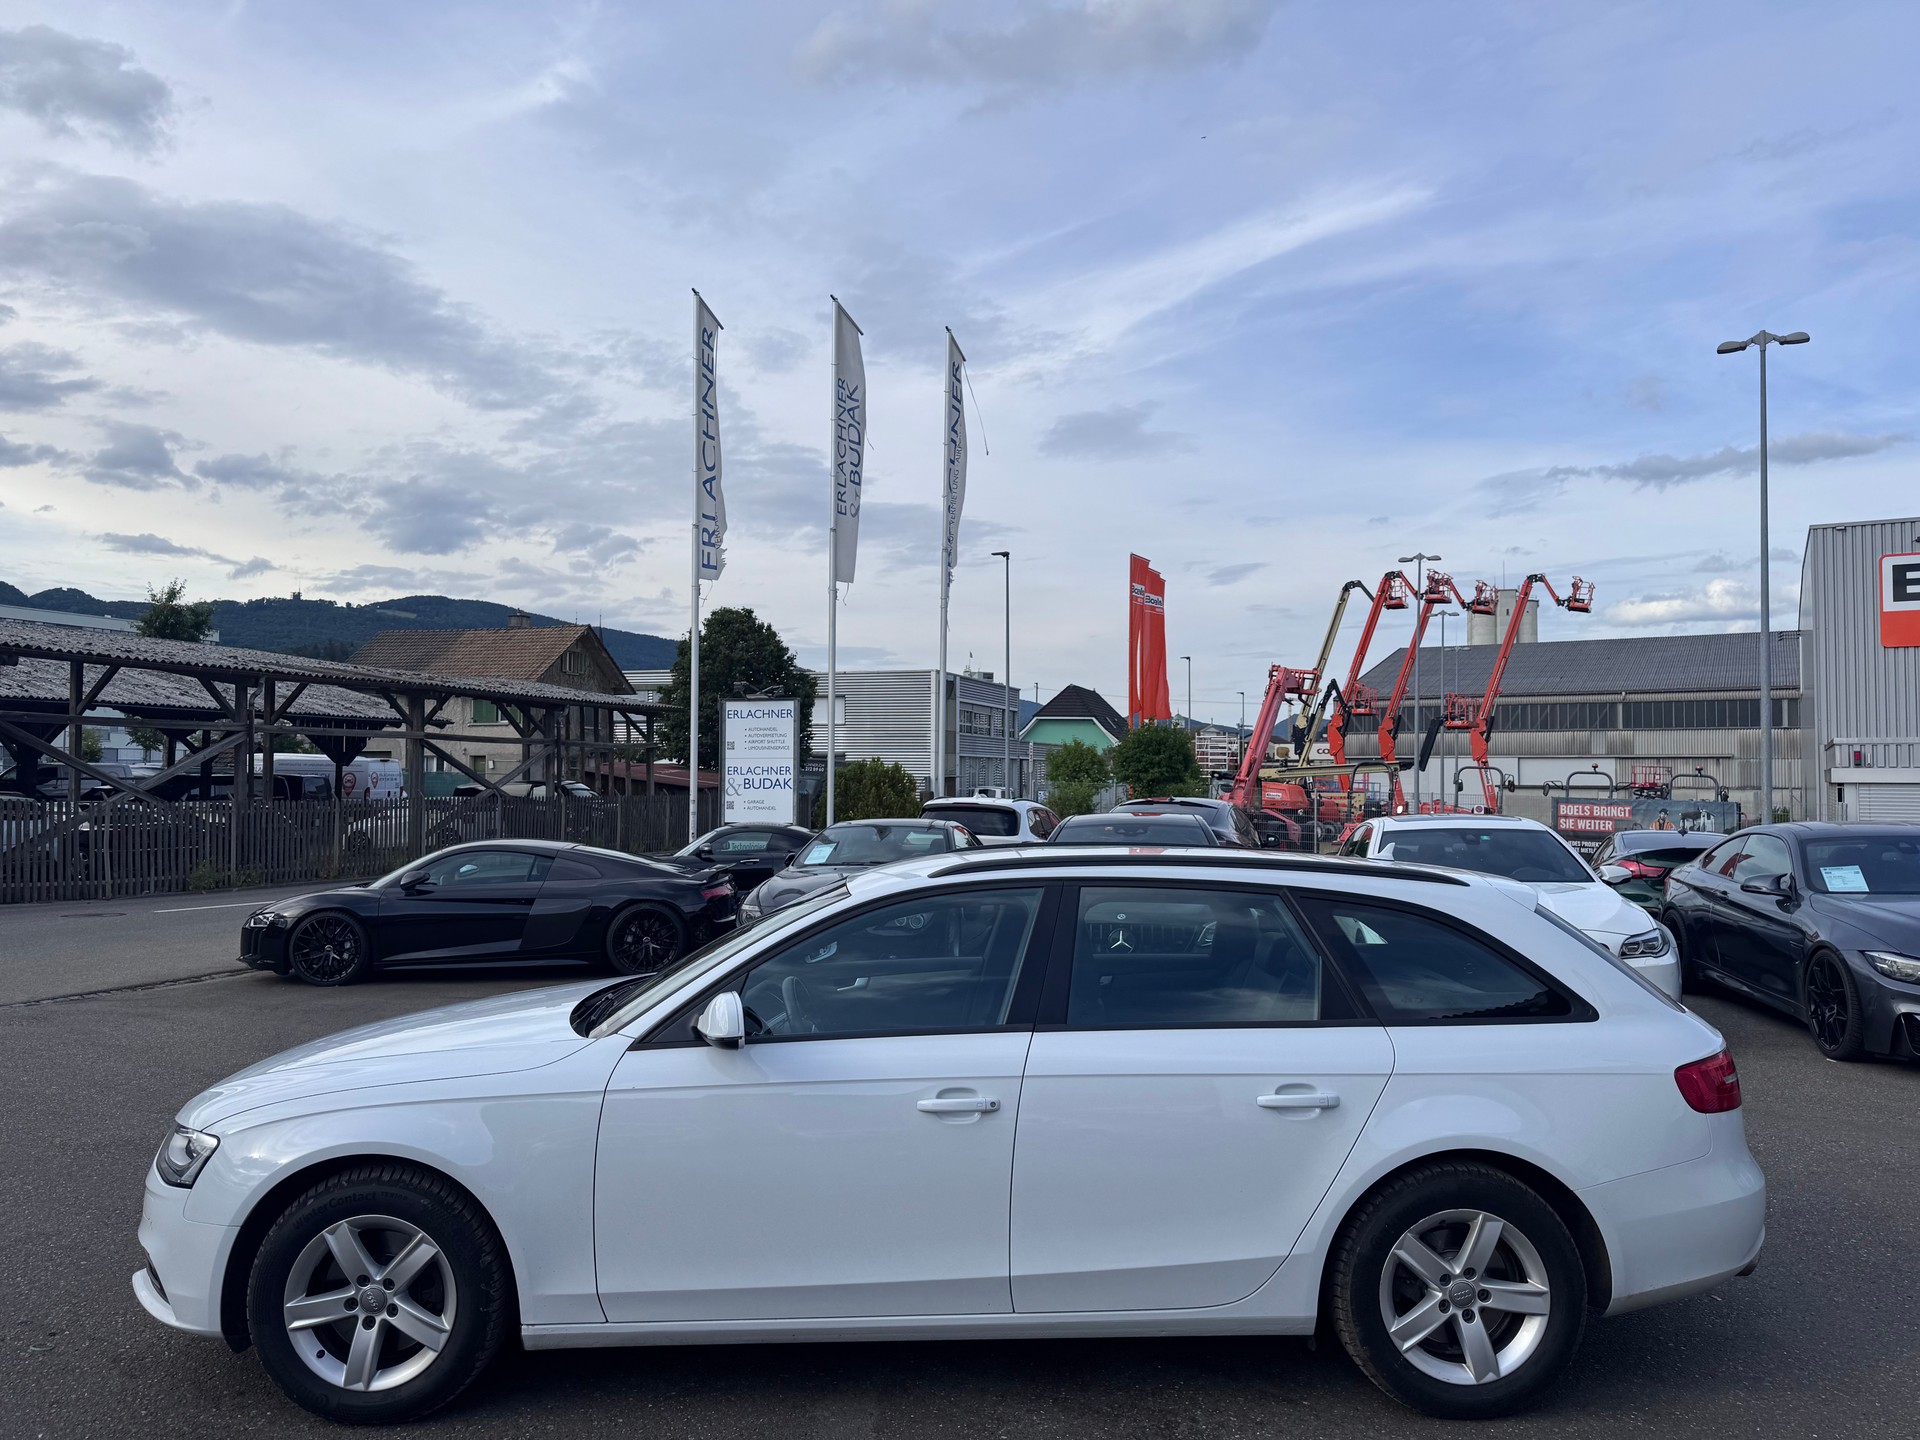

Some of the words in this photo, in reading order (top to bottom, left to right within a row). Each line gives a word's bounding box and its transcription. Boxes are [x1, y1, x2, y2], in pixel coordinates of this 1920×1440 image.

[846, 384, 862, 487] BUDAK
[836, 377, 847, 517] ERLACHNER
[727, 708, 793, 719] ERLACHNER
[727, 766, 791, 776] ERLACHNER
[726, 777, 743, 797] &
[743, 777, 792, 790] BUDAK
[1560, 804, 1591, 816] BOELS
[1593, 805, 1631, 818] BRINGT
[1560, 818, 1575, 829] SIE
[1577, 819, 1613, 831] WEITER
